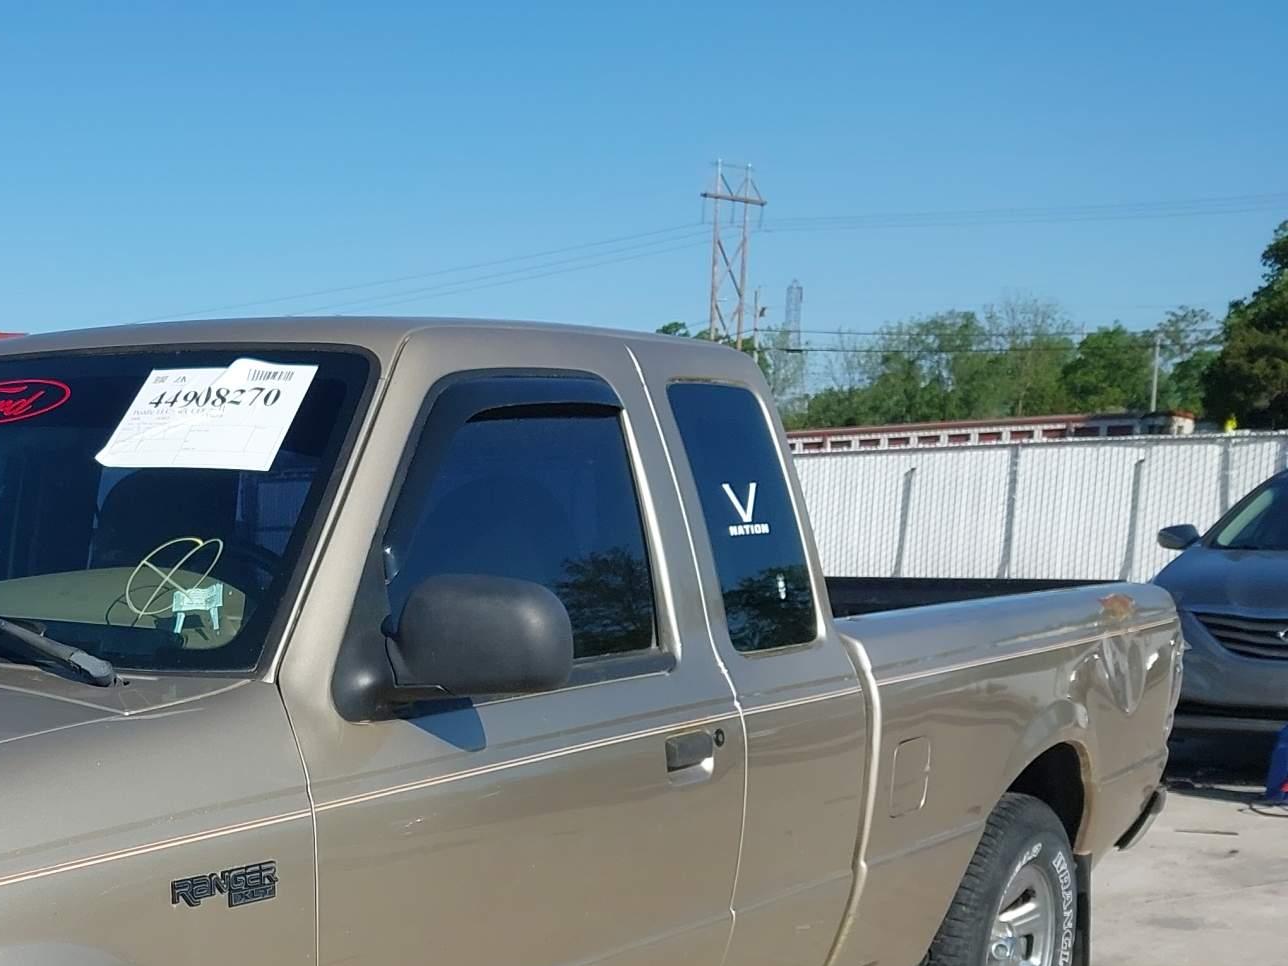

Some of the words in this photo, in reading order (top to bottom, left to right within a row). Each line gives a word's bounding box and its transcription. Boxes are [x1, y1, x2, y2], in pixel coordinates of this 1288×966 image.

[148, 386, 281, 409] 44908270
[721, 482, 757, 523] V
[728, 523, 770, 536] NATION
[171, 860, 278, 907] RANGER
